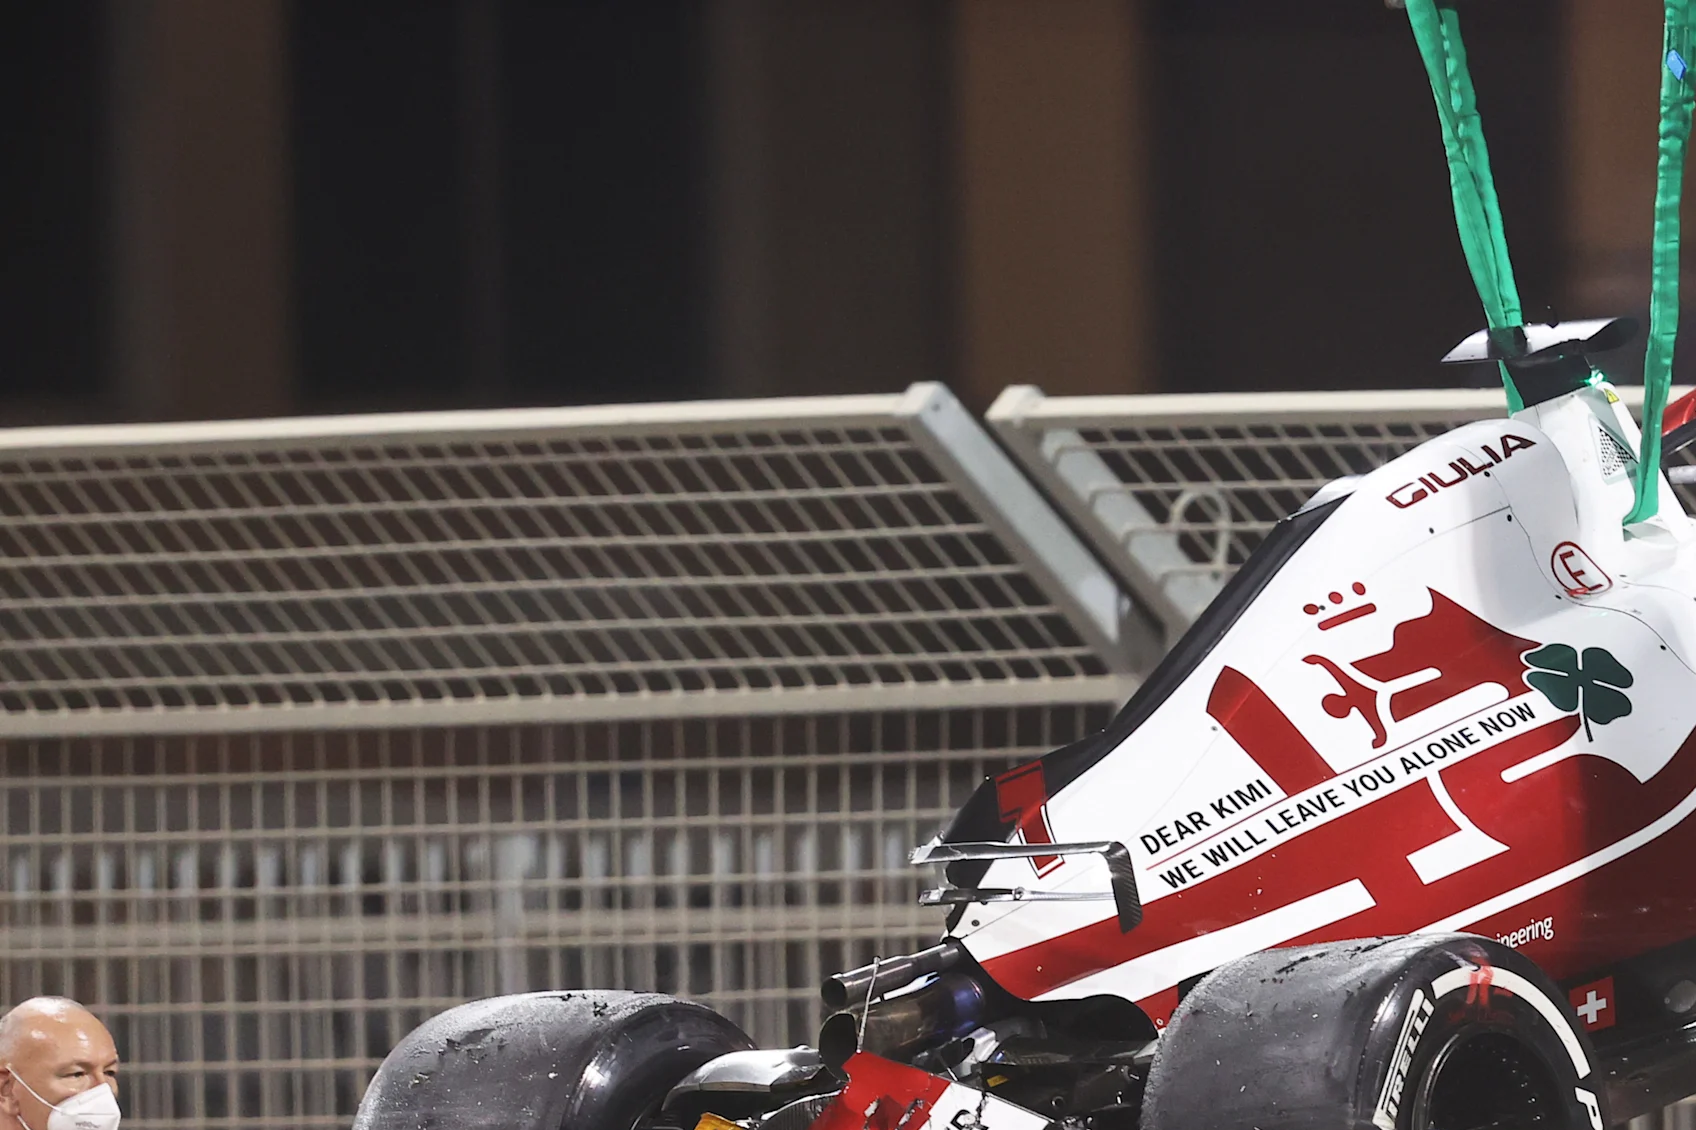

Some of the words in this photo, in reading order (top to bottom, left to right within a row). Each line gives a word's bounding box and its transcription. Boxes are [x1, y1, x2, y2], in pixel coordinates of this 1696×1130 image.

[1386, 434, 1537, 509] GIULIA
[1139, 811, 1211, 855] DEAR
[1215, 778, 1272, 819] KIMI
[1159, 859, 1204, 890] WE
[1202, 829, 1267, 867] WILL
[1265, 790, 1345, 836] LEAVE
[1342, 765, 1395, 799] YOU
[1400, 727, 1480, 775] ALONE
[1478, 702, 1536, 736] NOW
[1497, 916, 1554, 949] ineering
